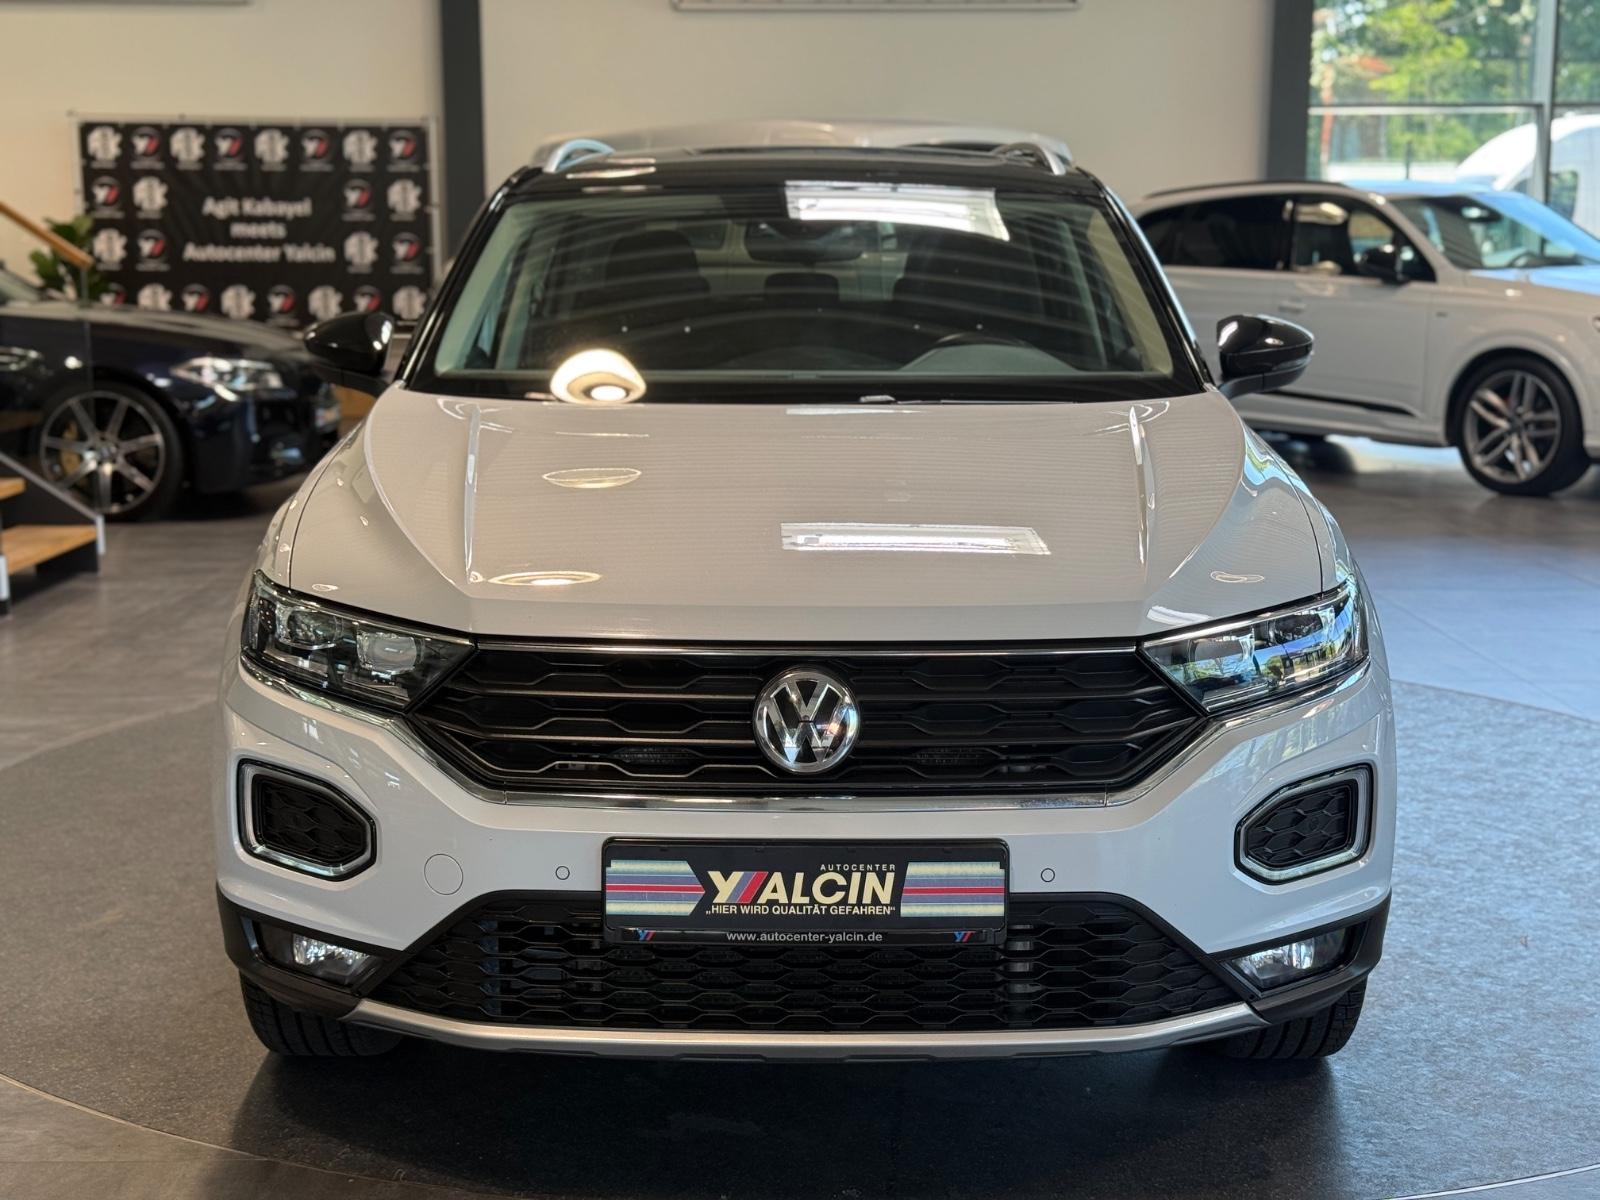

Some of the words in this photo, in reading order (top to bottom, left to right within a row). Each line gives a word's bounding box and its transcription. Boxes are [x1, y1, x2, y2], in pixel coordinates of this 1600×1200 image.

[202, 197, 240, 220] Agit
[230, 221, 287, 239] meets
[183, 242, 281, 262] Autocenter
[282, 242, 336, 263] Yalcin
[707, 870, 895, 905] YALCIN
[740, 905, 769, 915] WIRD
[772, 904, 827, 915] QUALITÄT
[726, 931, 883, 944] www.autocenter-yalcin.de
